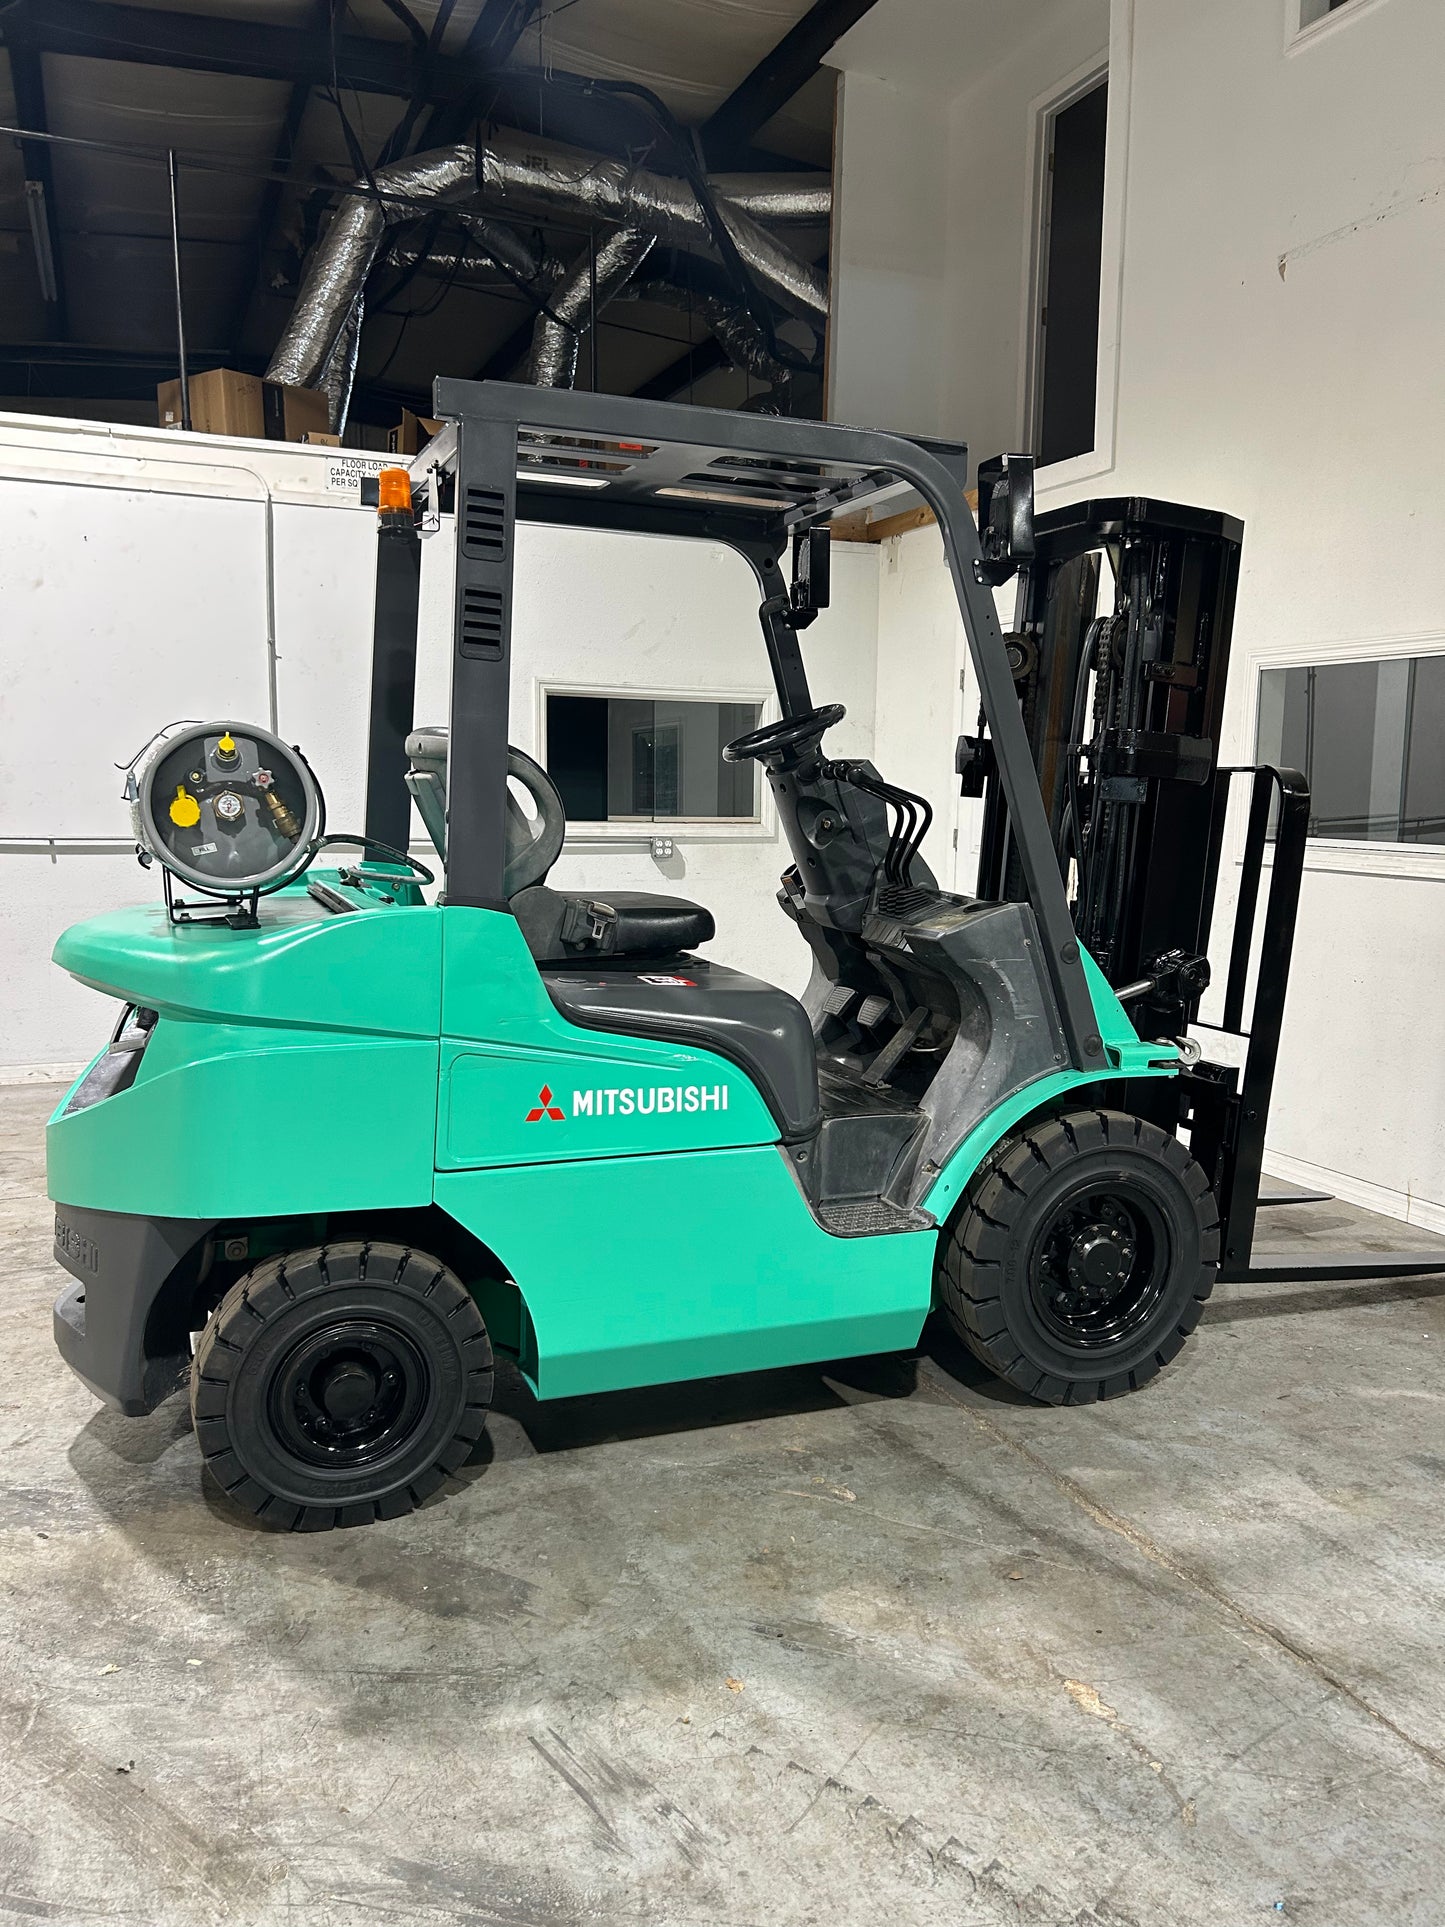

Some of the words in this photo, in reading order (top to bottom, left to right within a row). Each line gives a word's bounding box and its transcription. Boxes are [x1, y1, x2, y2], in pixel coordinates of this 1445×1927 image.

[341, 459, 367, 469] FLOOR
[330, 467, 367, 478] CAPACITY
[331, 477, 346, 486] PER
[347, 479, 358, 487] SQ
[572, 1084, 729, 1117] MITSUBISHI
